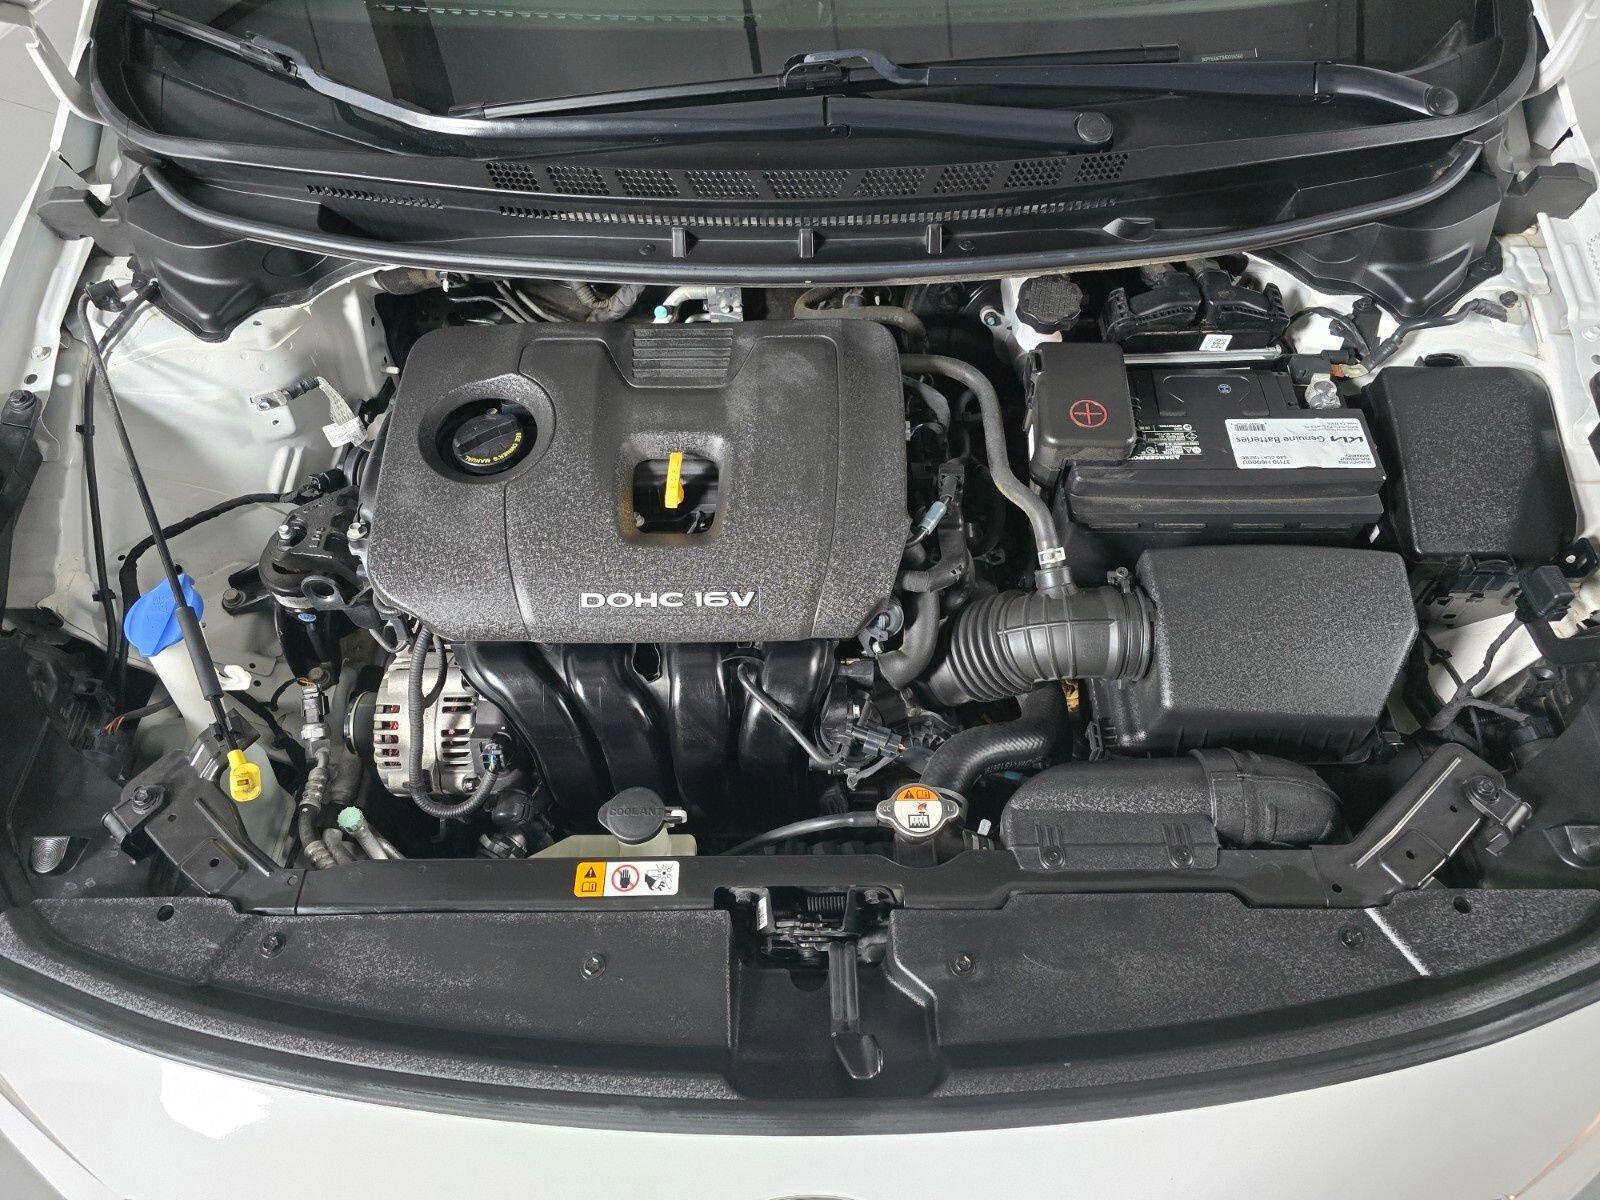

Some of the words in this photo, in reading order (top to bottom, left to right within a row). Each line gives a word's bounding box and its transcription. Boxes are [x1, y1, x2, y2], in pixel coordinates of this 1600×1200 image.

[514, 432, 522, 443] SEE
[1235, 436, 1281, 444] Batteries
[1283, 435, 1325, 443] Genuine
[493, 443, 518, 461] OWNER'S
[465, 455, 491, 463] MANUAL
[580, 592, 684, 608] DOHC
[694, 591, 756, 608] 16V
[609, 807, 664, 817] COOLANT
